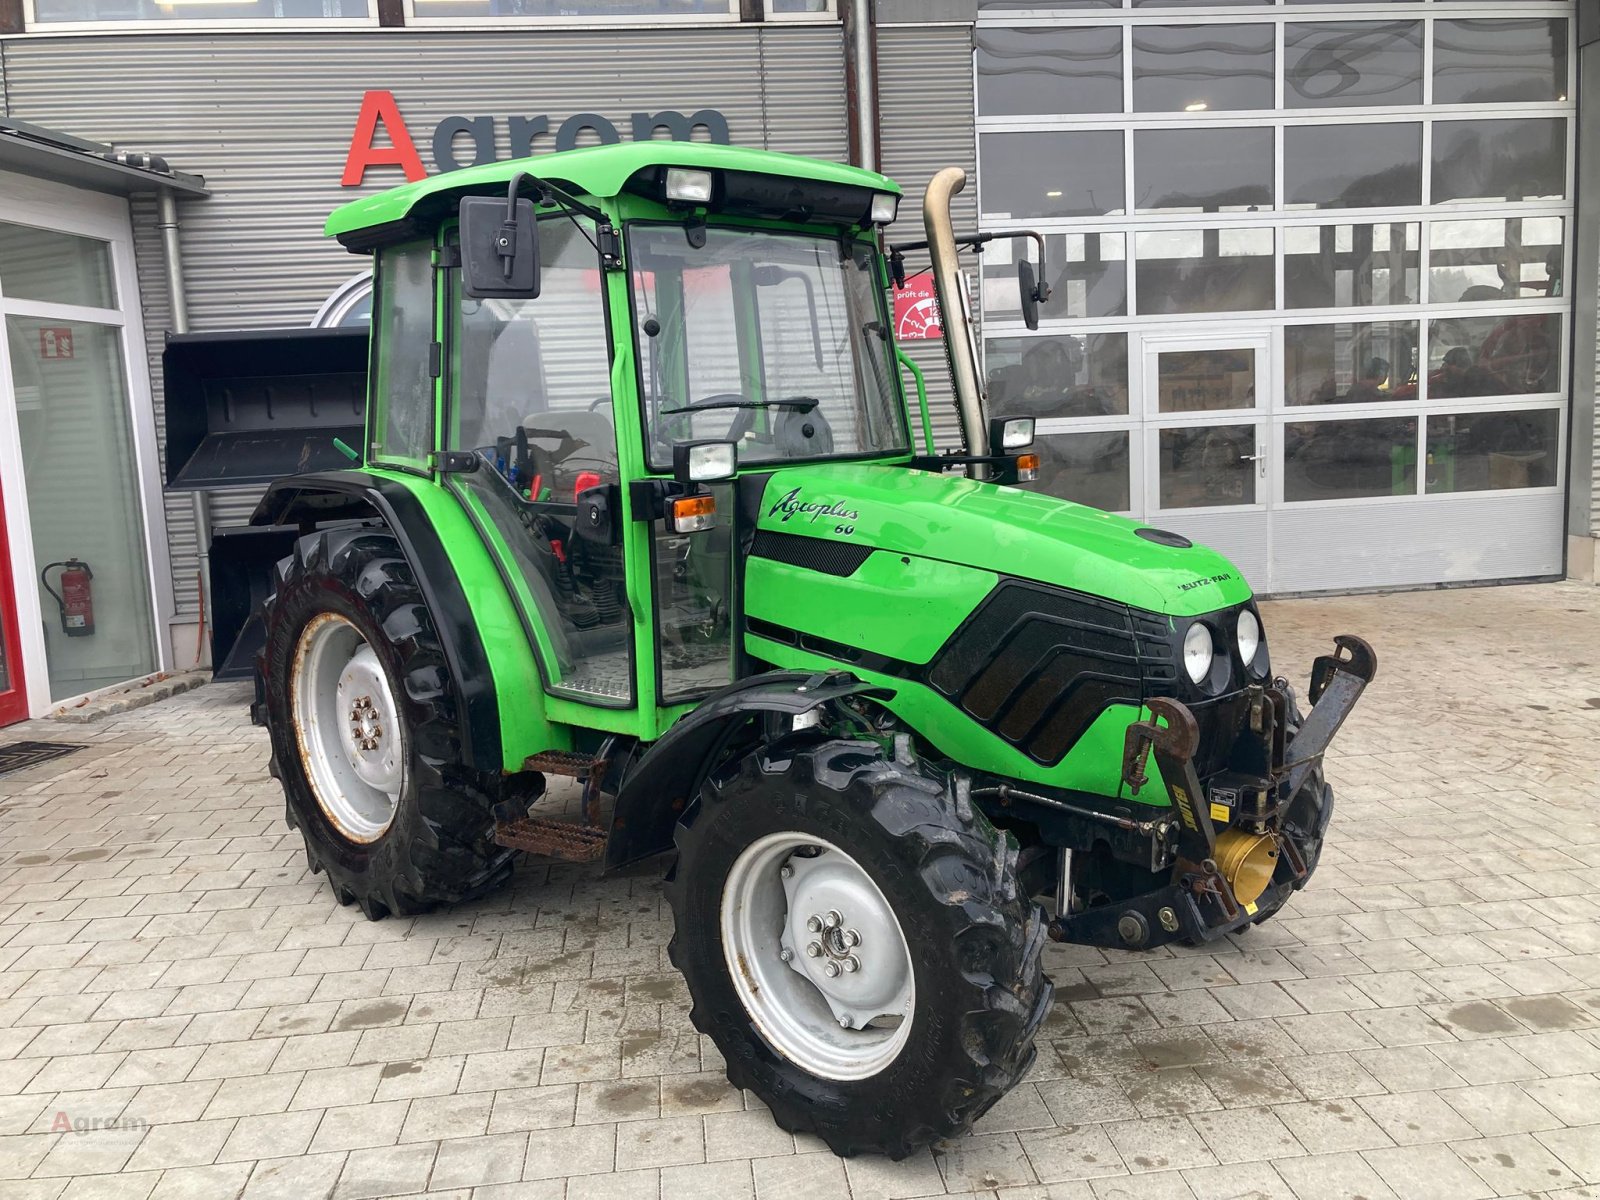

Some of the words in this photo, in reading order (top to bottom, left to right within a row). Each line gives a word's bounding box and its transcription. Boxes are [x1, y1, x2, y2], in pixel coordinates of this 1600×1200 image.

[341, 89, 729, 187] Agrom
[897, 290, 917, 300] prüft
[918, 290, 929, 298] die
[910, 320, 920, 329] 2
[768, 486, 858, 524] Agroplus
